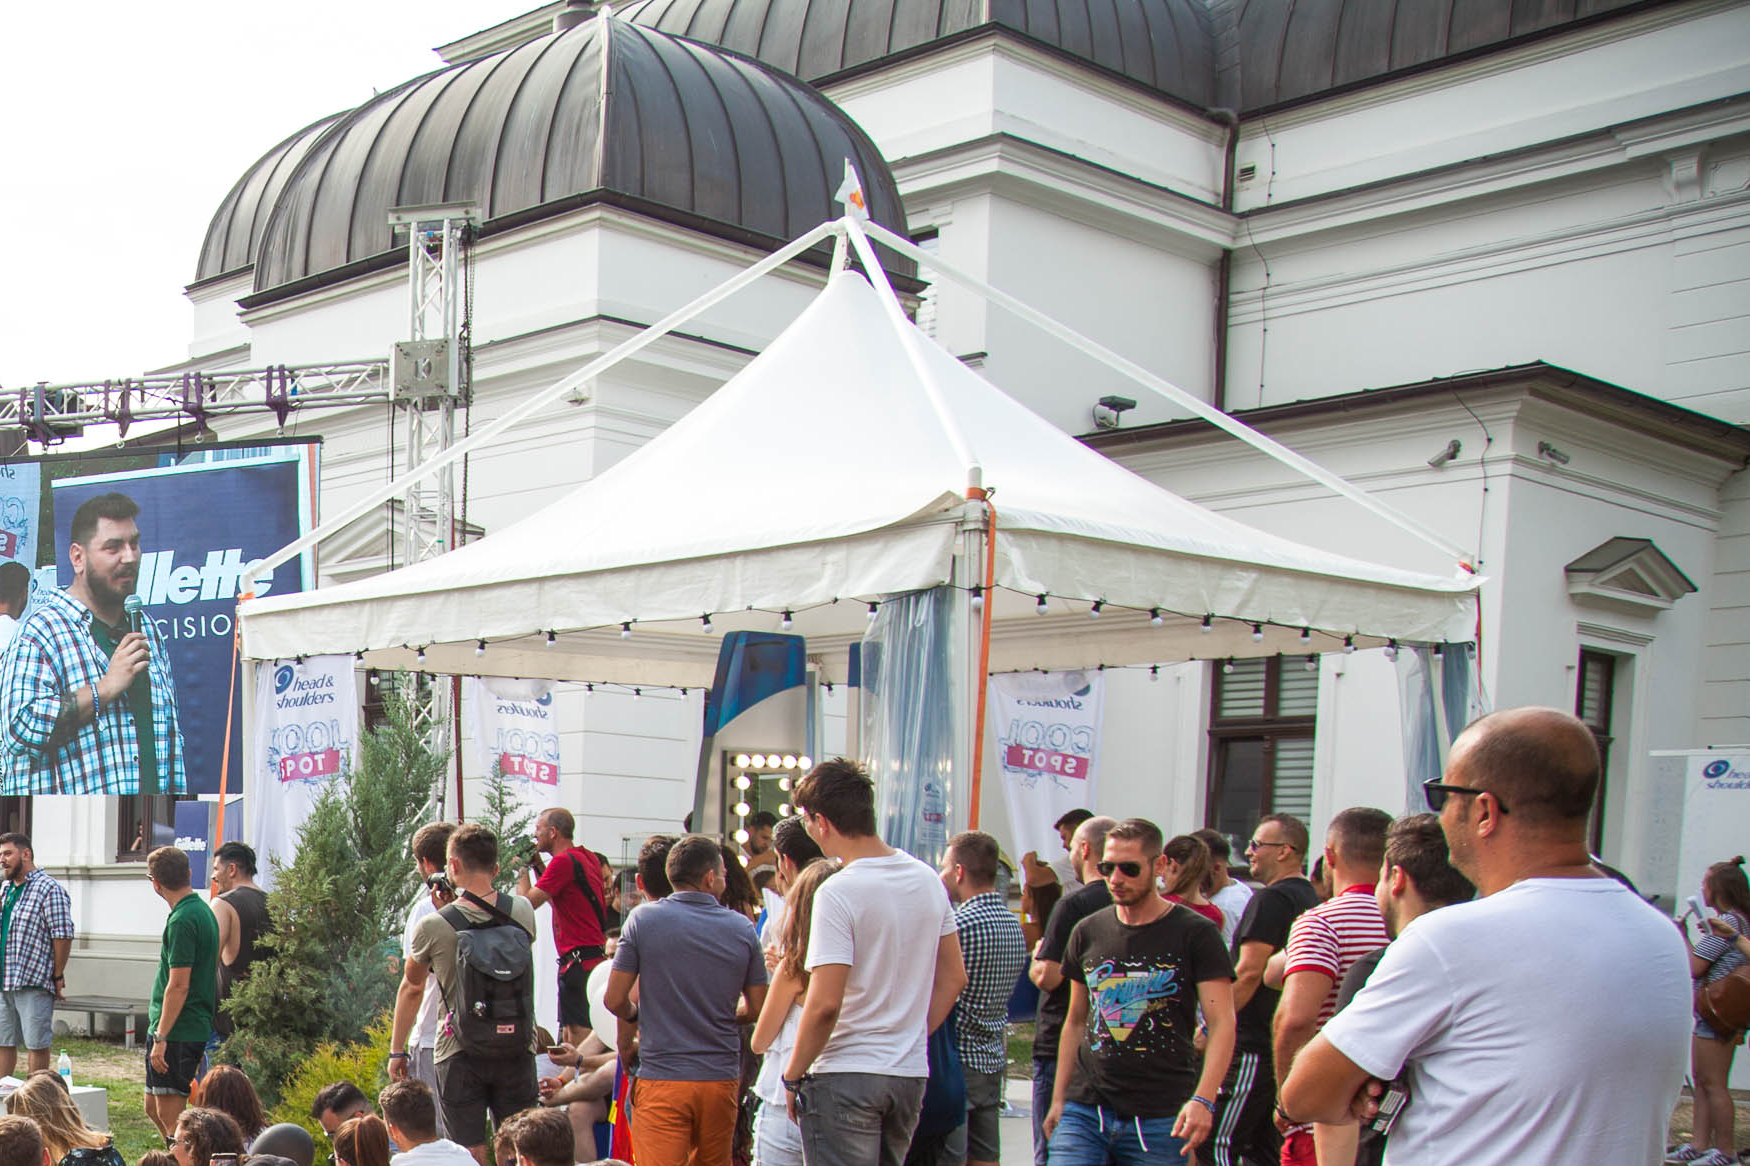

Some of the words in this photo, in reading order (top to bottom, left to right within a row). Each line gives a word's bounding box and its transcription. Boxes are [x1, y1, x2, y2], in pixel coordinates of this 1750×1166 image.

[156, 613, 232, 640] CISIO
[293, 673, 326, 692] head
[325, 675, 335, 688] &
[276, 690, 335, 710] shoulders
[175, 836, 207, 851] Gillette
